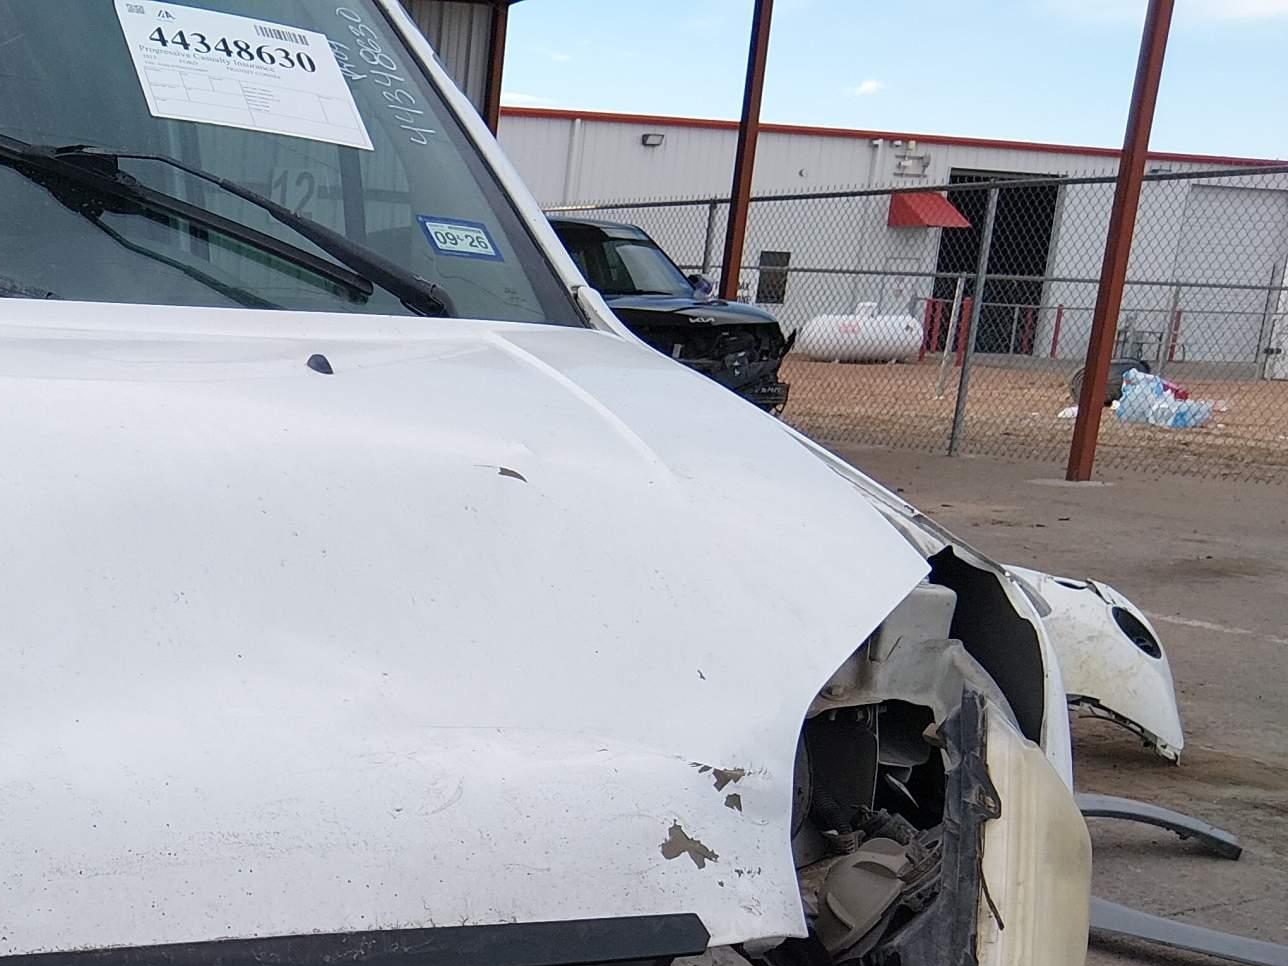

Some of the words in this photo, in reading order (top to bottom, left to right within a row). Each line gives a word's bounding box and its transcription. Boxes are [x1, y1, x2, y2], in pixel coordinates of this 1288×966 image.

[149, 26, 316, 73] 44348630
[335, 7, 436, 145] 44348630
[273, 170, 315, 218] 12
[434, 231, 459, 246] 09
